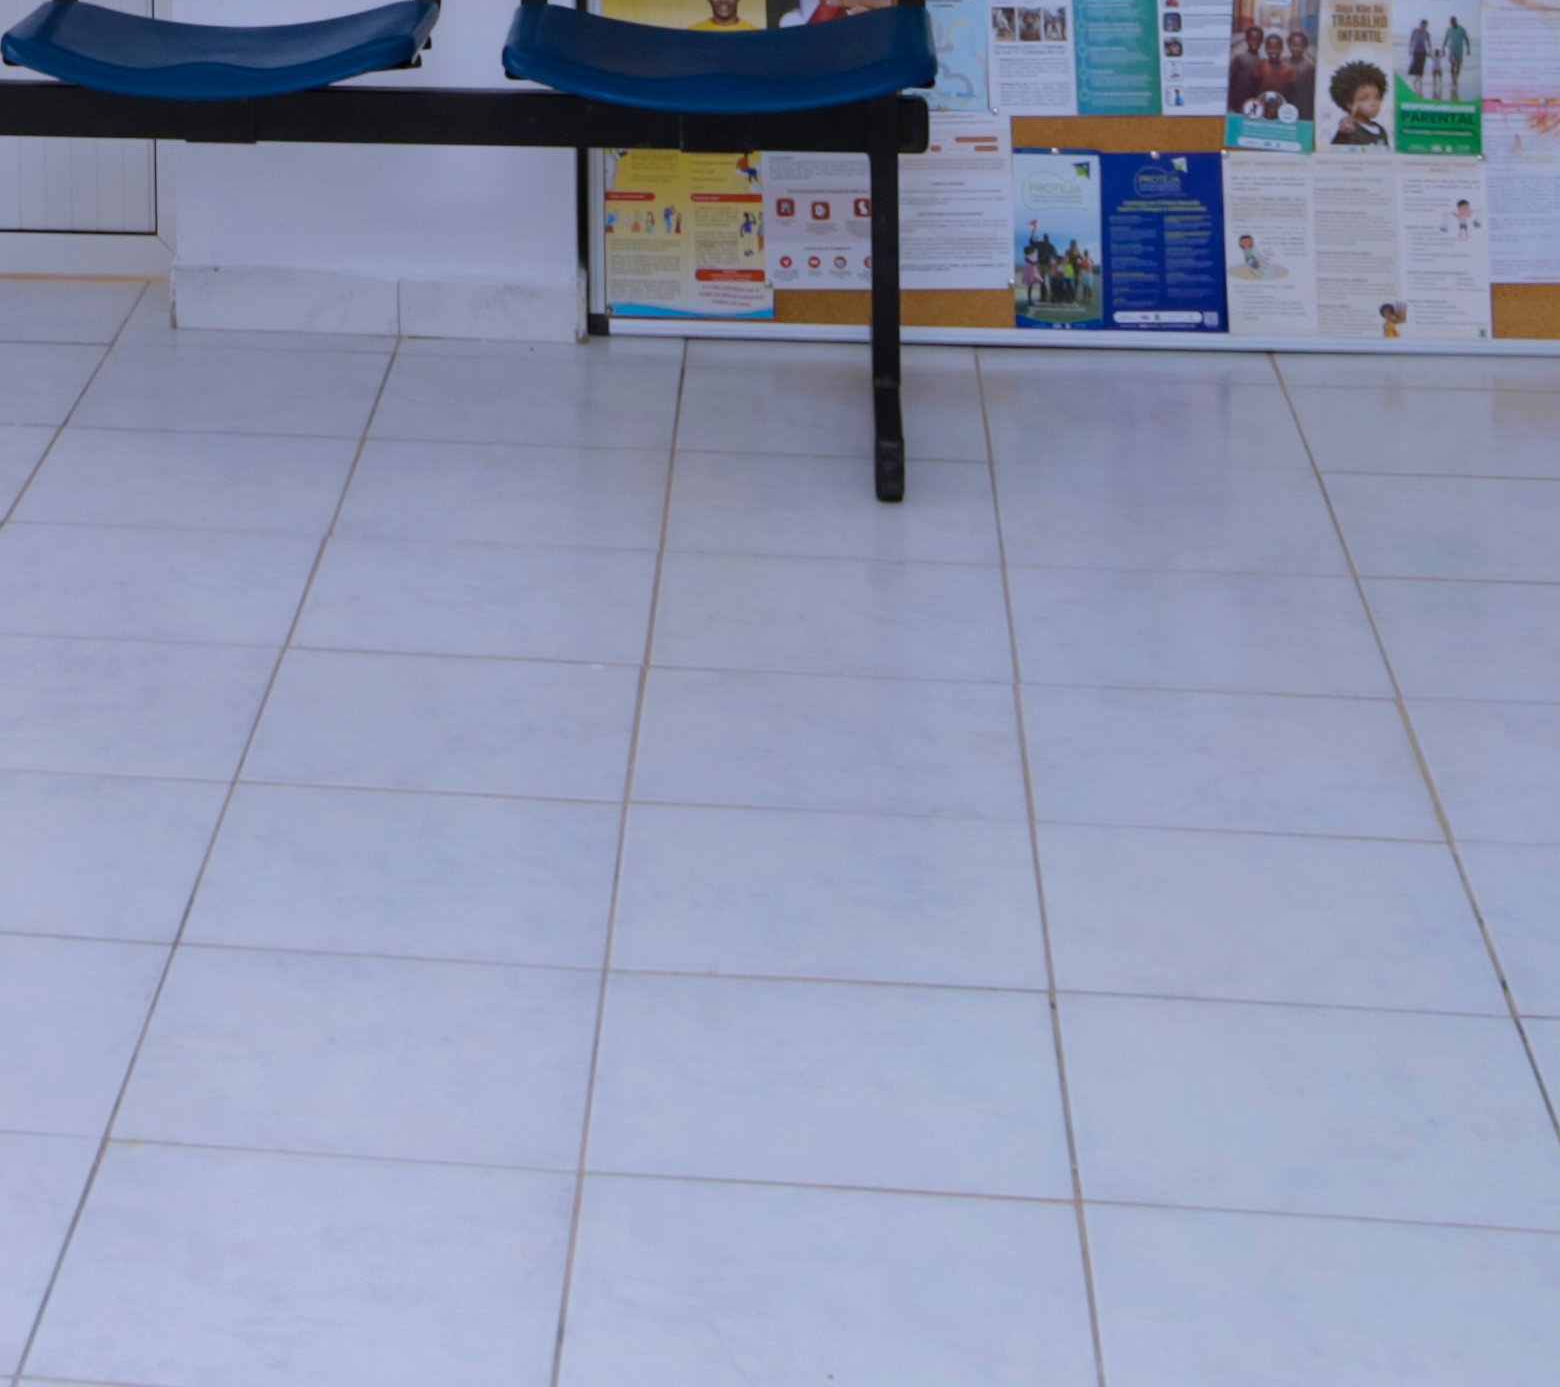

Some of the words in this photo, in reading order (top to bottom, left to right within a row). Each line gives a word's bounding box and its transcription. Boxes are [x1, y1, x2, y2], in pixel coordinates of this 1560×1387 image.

[1332, 15, 1388, 28] TRABALHO
[1337, 30, 1383, 43] INFANTIL
[1400, 112, 1475, 125] PARENTAL
[1028, 182, 1082, 194] PROTEJA
